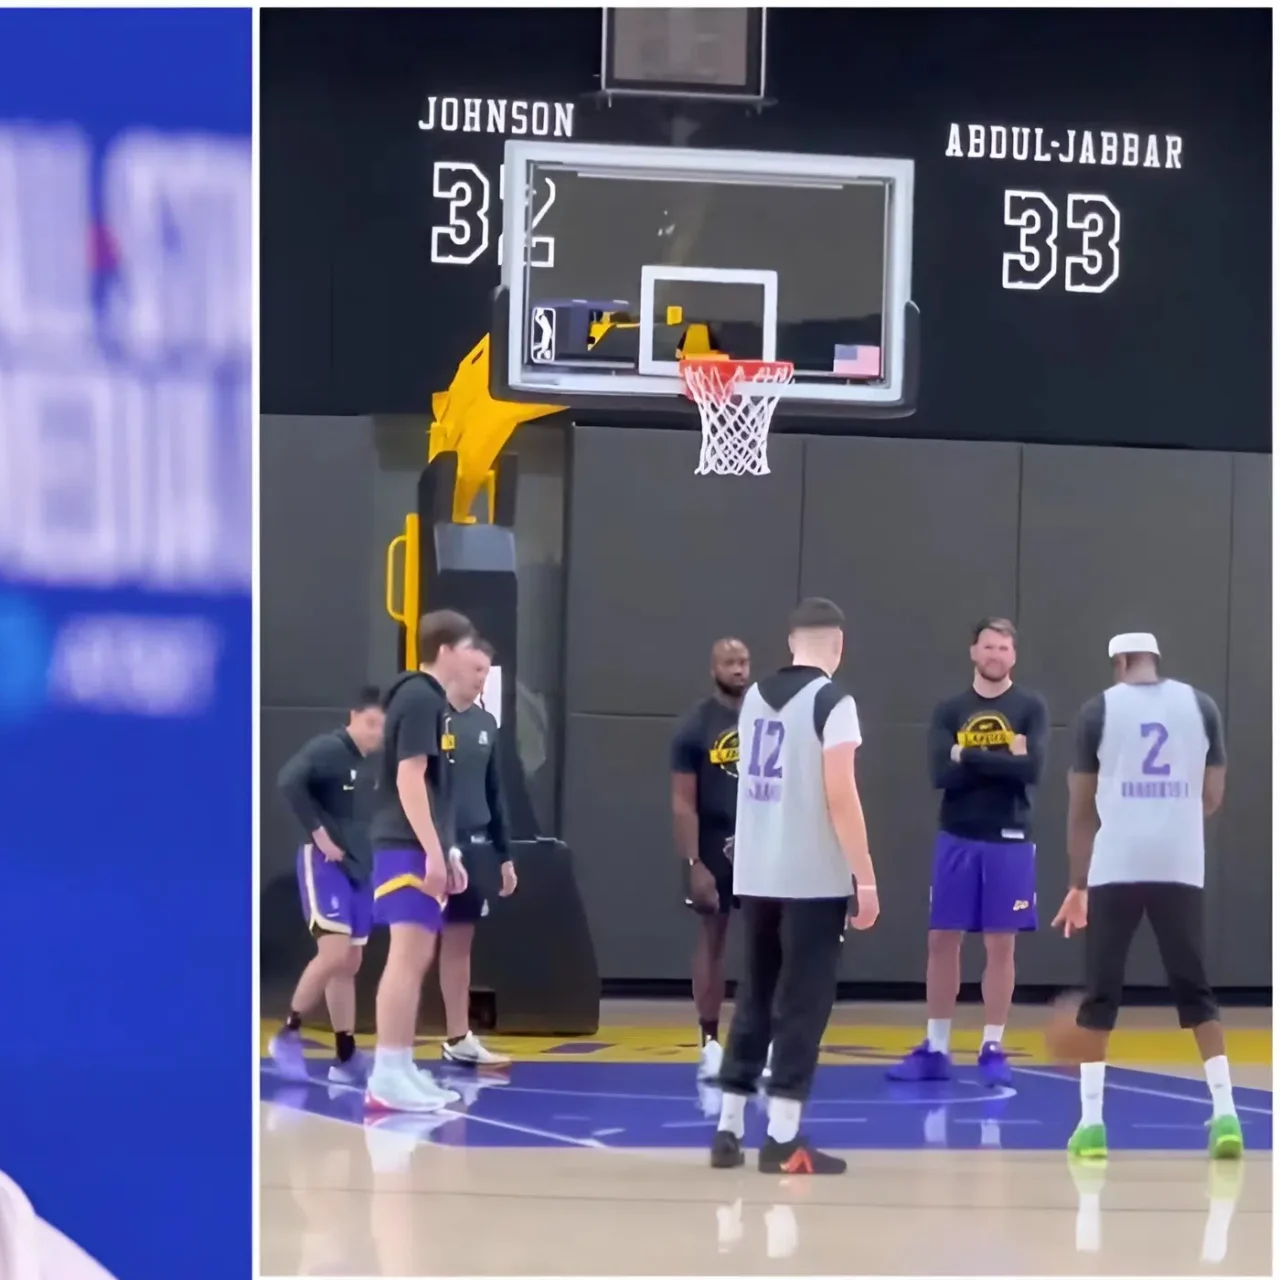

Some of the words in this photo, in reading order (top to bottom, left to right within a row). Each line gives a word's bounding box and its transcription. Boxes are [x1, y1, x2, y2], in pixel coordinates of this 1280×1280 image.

[418, 96, 575, 137] JOHNSON
[945, 123, 1183, 169] ABDUL-JABBAR
[1002, 189, 1120, 293] 33
[748, 718, 786, 779] 12
[1140, 722, 1171, 776] 2
